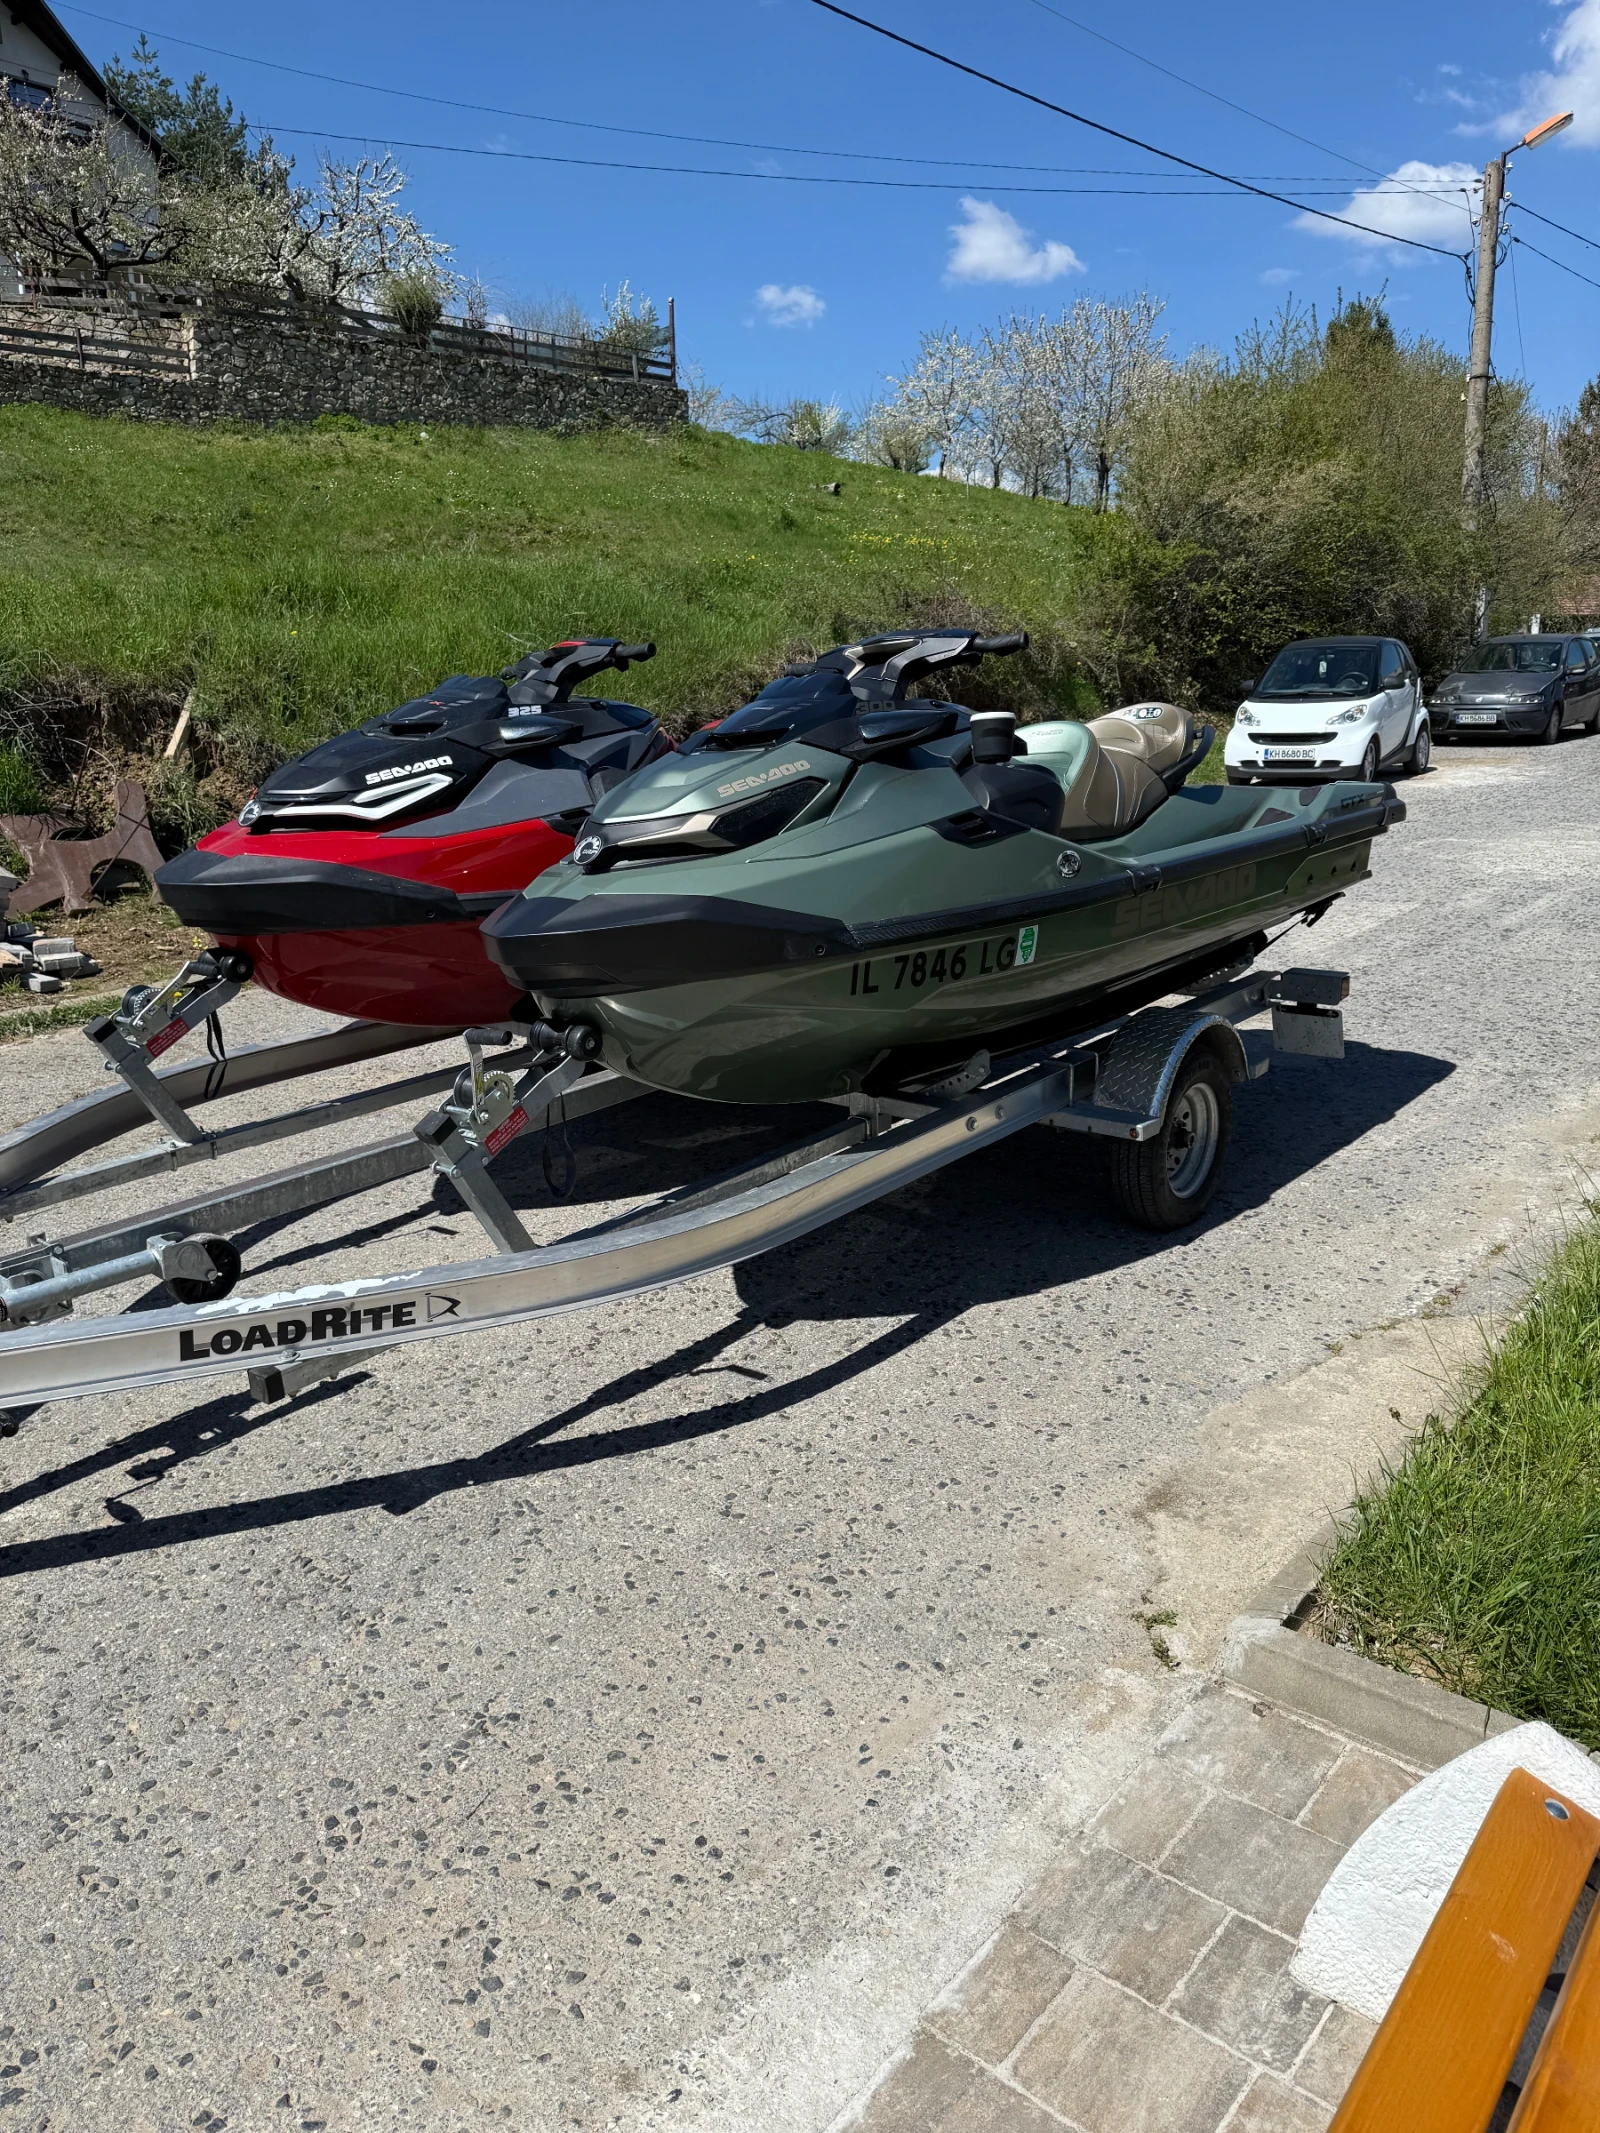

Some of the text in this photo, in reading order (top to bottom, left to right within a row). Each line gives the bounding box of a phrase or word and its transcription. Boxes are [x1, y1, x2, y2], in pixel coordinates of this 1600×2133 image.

[508, 705, 542, 718] 325
[856, 700, 896, 714] 300
[1269, 750, 1313, 758] KH 8680 BC
[850, 961, 879, 996] IL
[894, 945, 967, 989] 7846
[979, 936, 1017, 974] LG
